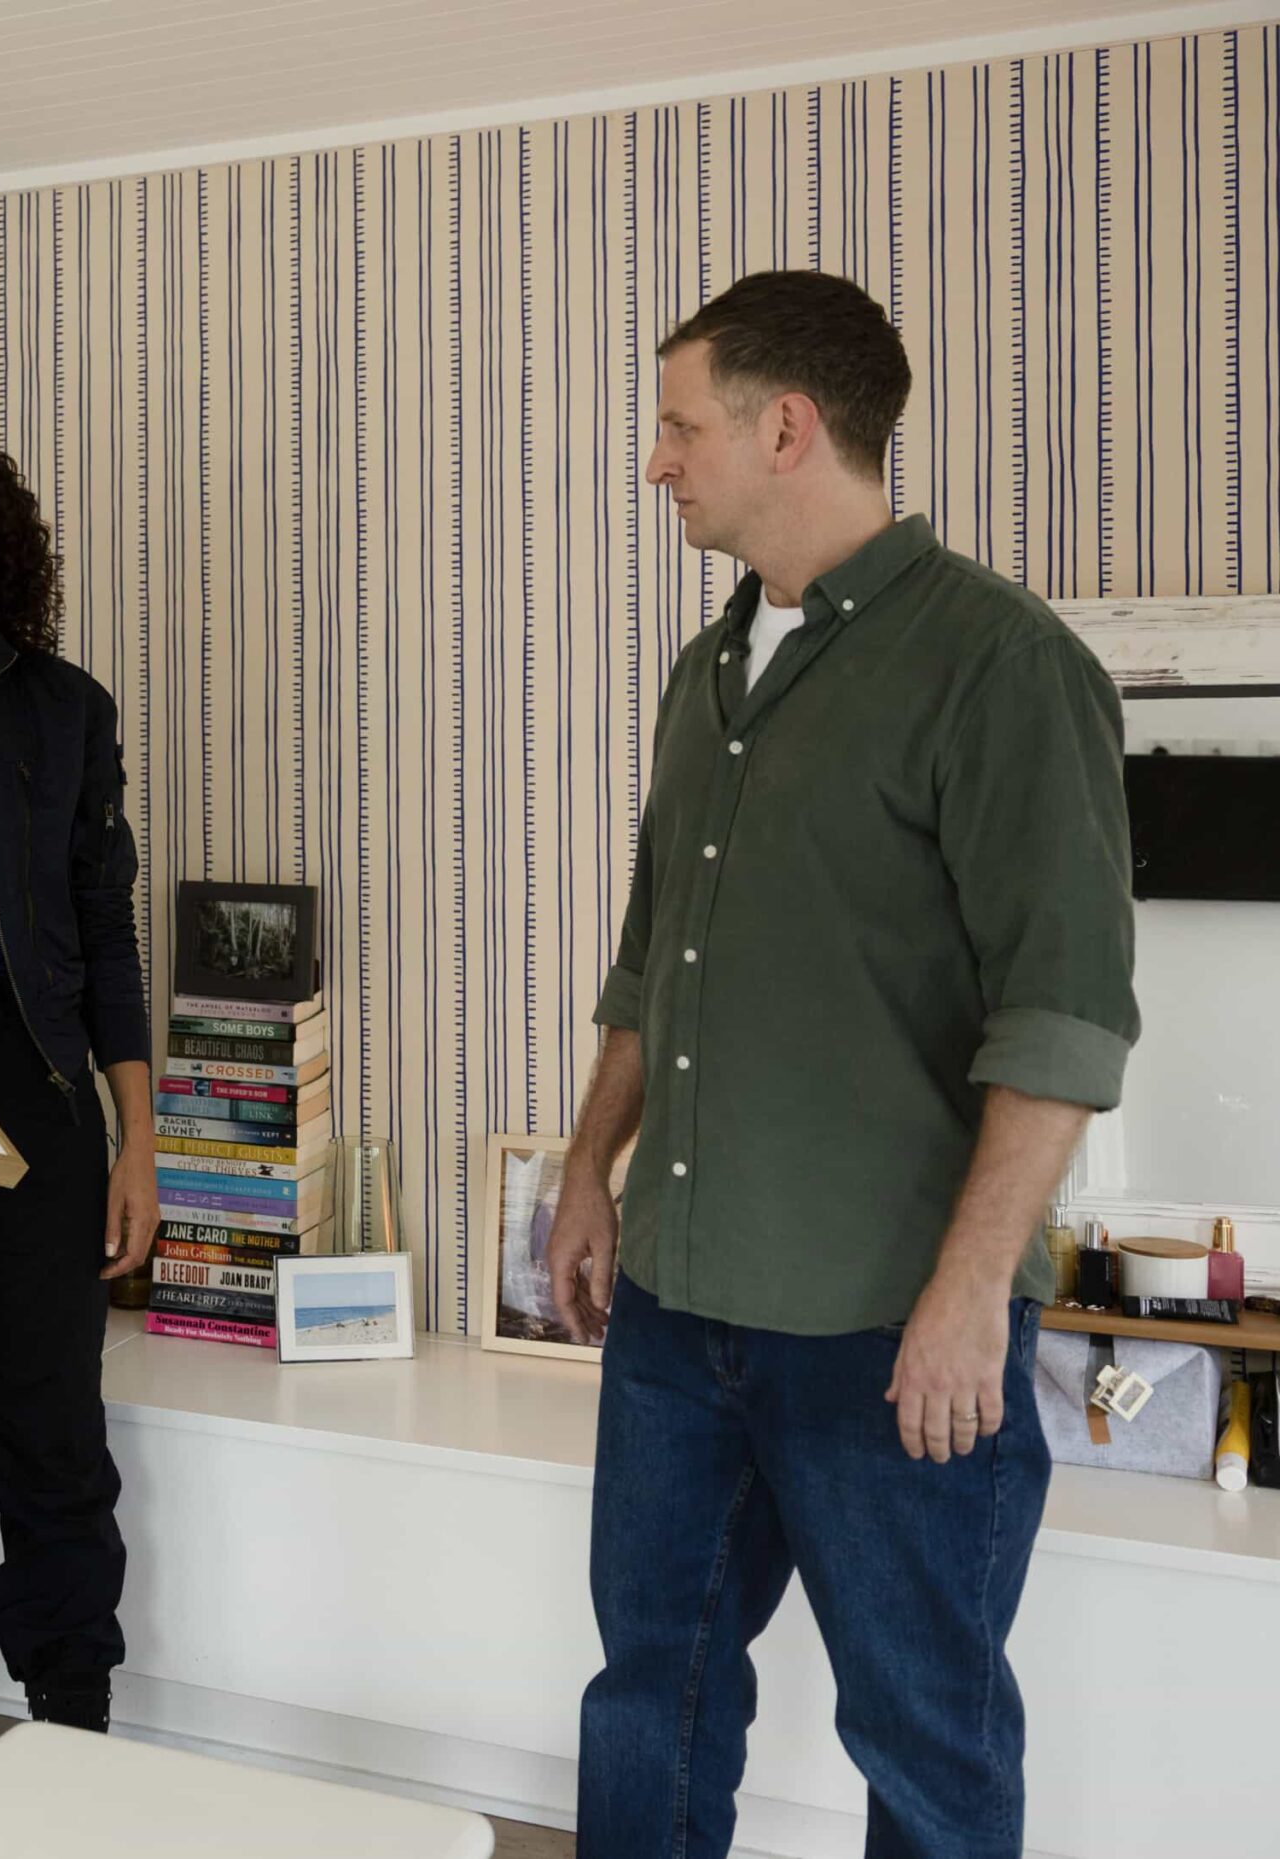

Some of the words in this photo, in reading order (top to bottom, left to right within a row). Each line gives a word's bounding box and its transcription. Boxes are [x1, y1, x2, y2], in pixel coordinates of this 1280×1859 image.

[213, 1023, 243, 1034] SOME
[246, 1025, 275, 1036] BOYS
[184, 1039, 232, 1058] BEAUTIFUL
[235, 1043, 264, 1060] CHAOS
[159, 1125, 202, 1137] GIVNEY
[164, 1117, 197, 1127] RACHEL
[239, 1147, 283, 1161] GUESTS
[177, 1160, 197, 1171] CITY
[215, 1165, 257, 1177] THIEVES
[165, 1223, 194, 1240] JANE
[197, 1226, 227, 1244] CARO
[232, 1232, 246, 1244] THE
[248, 1235, 280, 1249] MOTHER
[164, 1243, 188, 1257] John
[191, 1246, 232, 1263] Grisham
[160, 1263, 210, 1286] BLEEDOUT
[220, 1271, 242, 1286] JOAN
[244, 1274, 272, 1290] BRADY
[162, 1290, 195, 1304] HEART
[202, 1295, 227, 1308] RITZ
[155, 1315, 206, 1329] Susannah
[208, 1320, 271, 1338] Constantine
